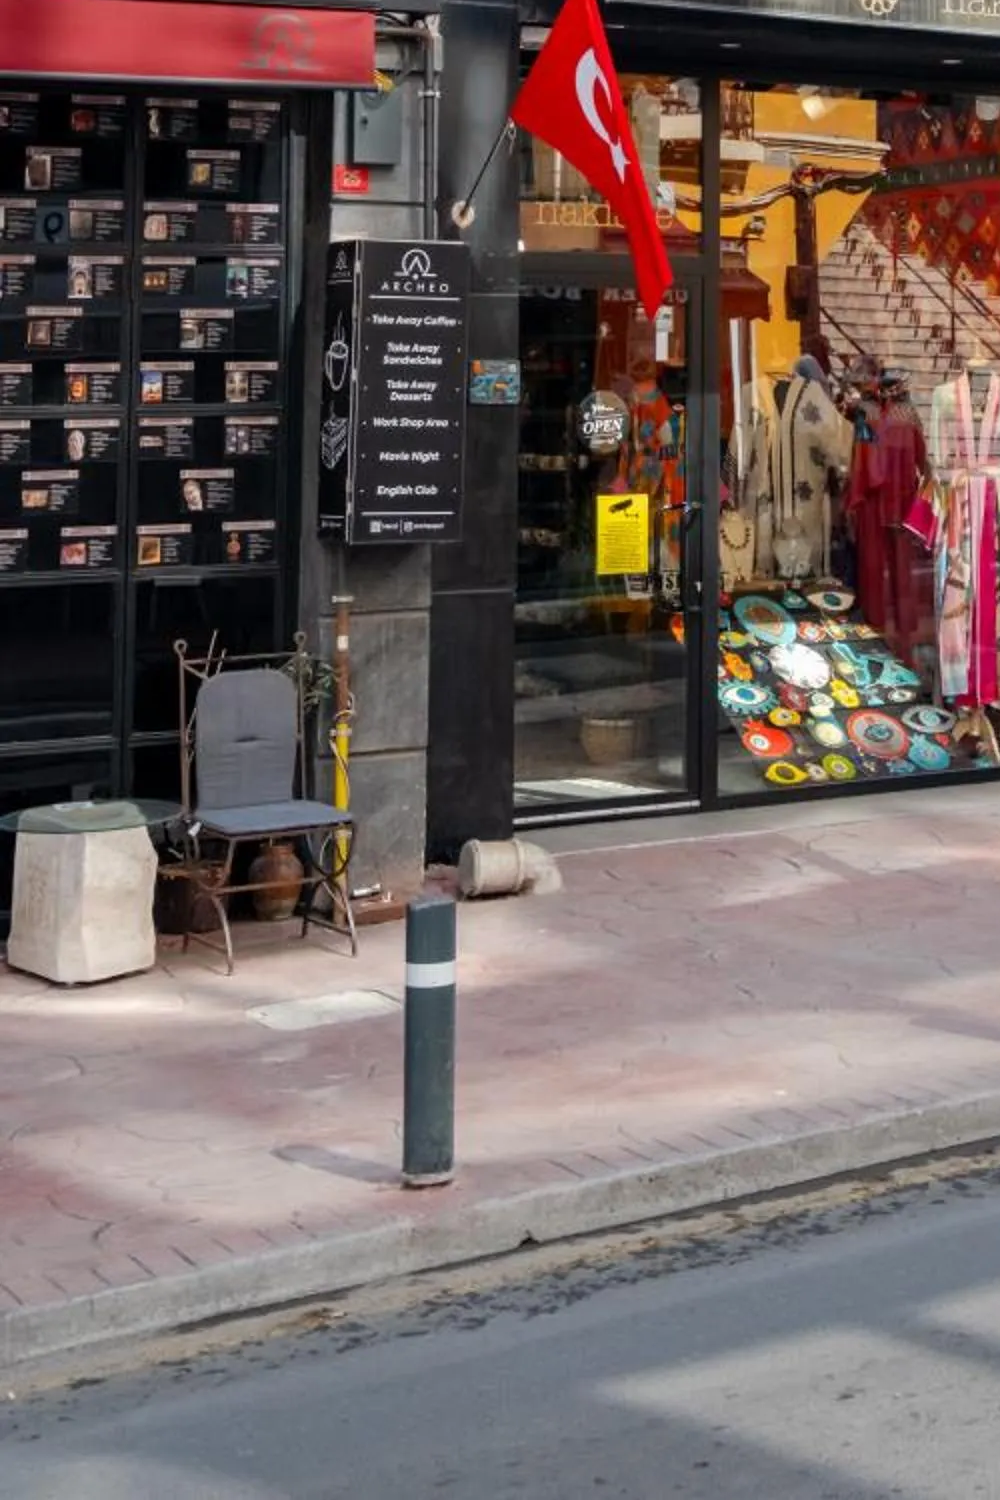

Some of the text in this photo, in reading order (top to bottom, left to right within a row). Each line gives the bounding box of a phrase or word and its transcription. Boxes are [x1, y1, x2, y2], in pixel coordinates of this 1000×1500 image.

[381, 281, 449, 293] ARCHEO
[372, 313, 457, 328] Take Away Coffee
[386, 342, 440, 356] Take Away
[383, 354, 443, 365] Sandwiches
[386, 379, 437, 392] Take Away
[390, 391, 433, 401] Desserts
[373, 417, 449, 429] Work Shop Area
[583, 418, 623, 434] OPEN
[380, 451, 440, 464] Movie Night
[377, 485, 439, 498] English Club
